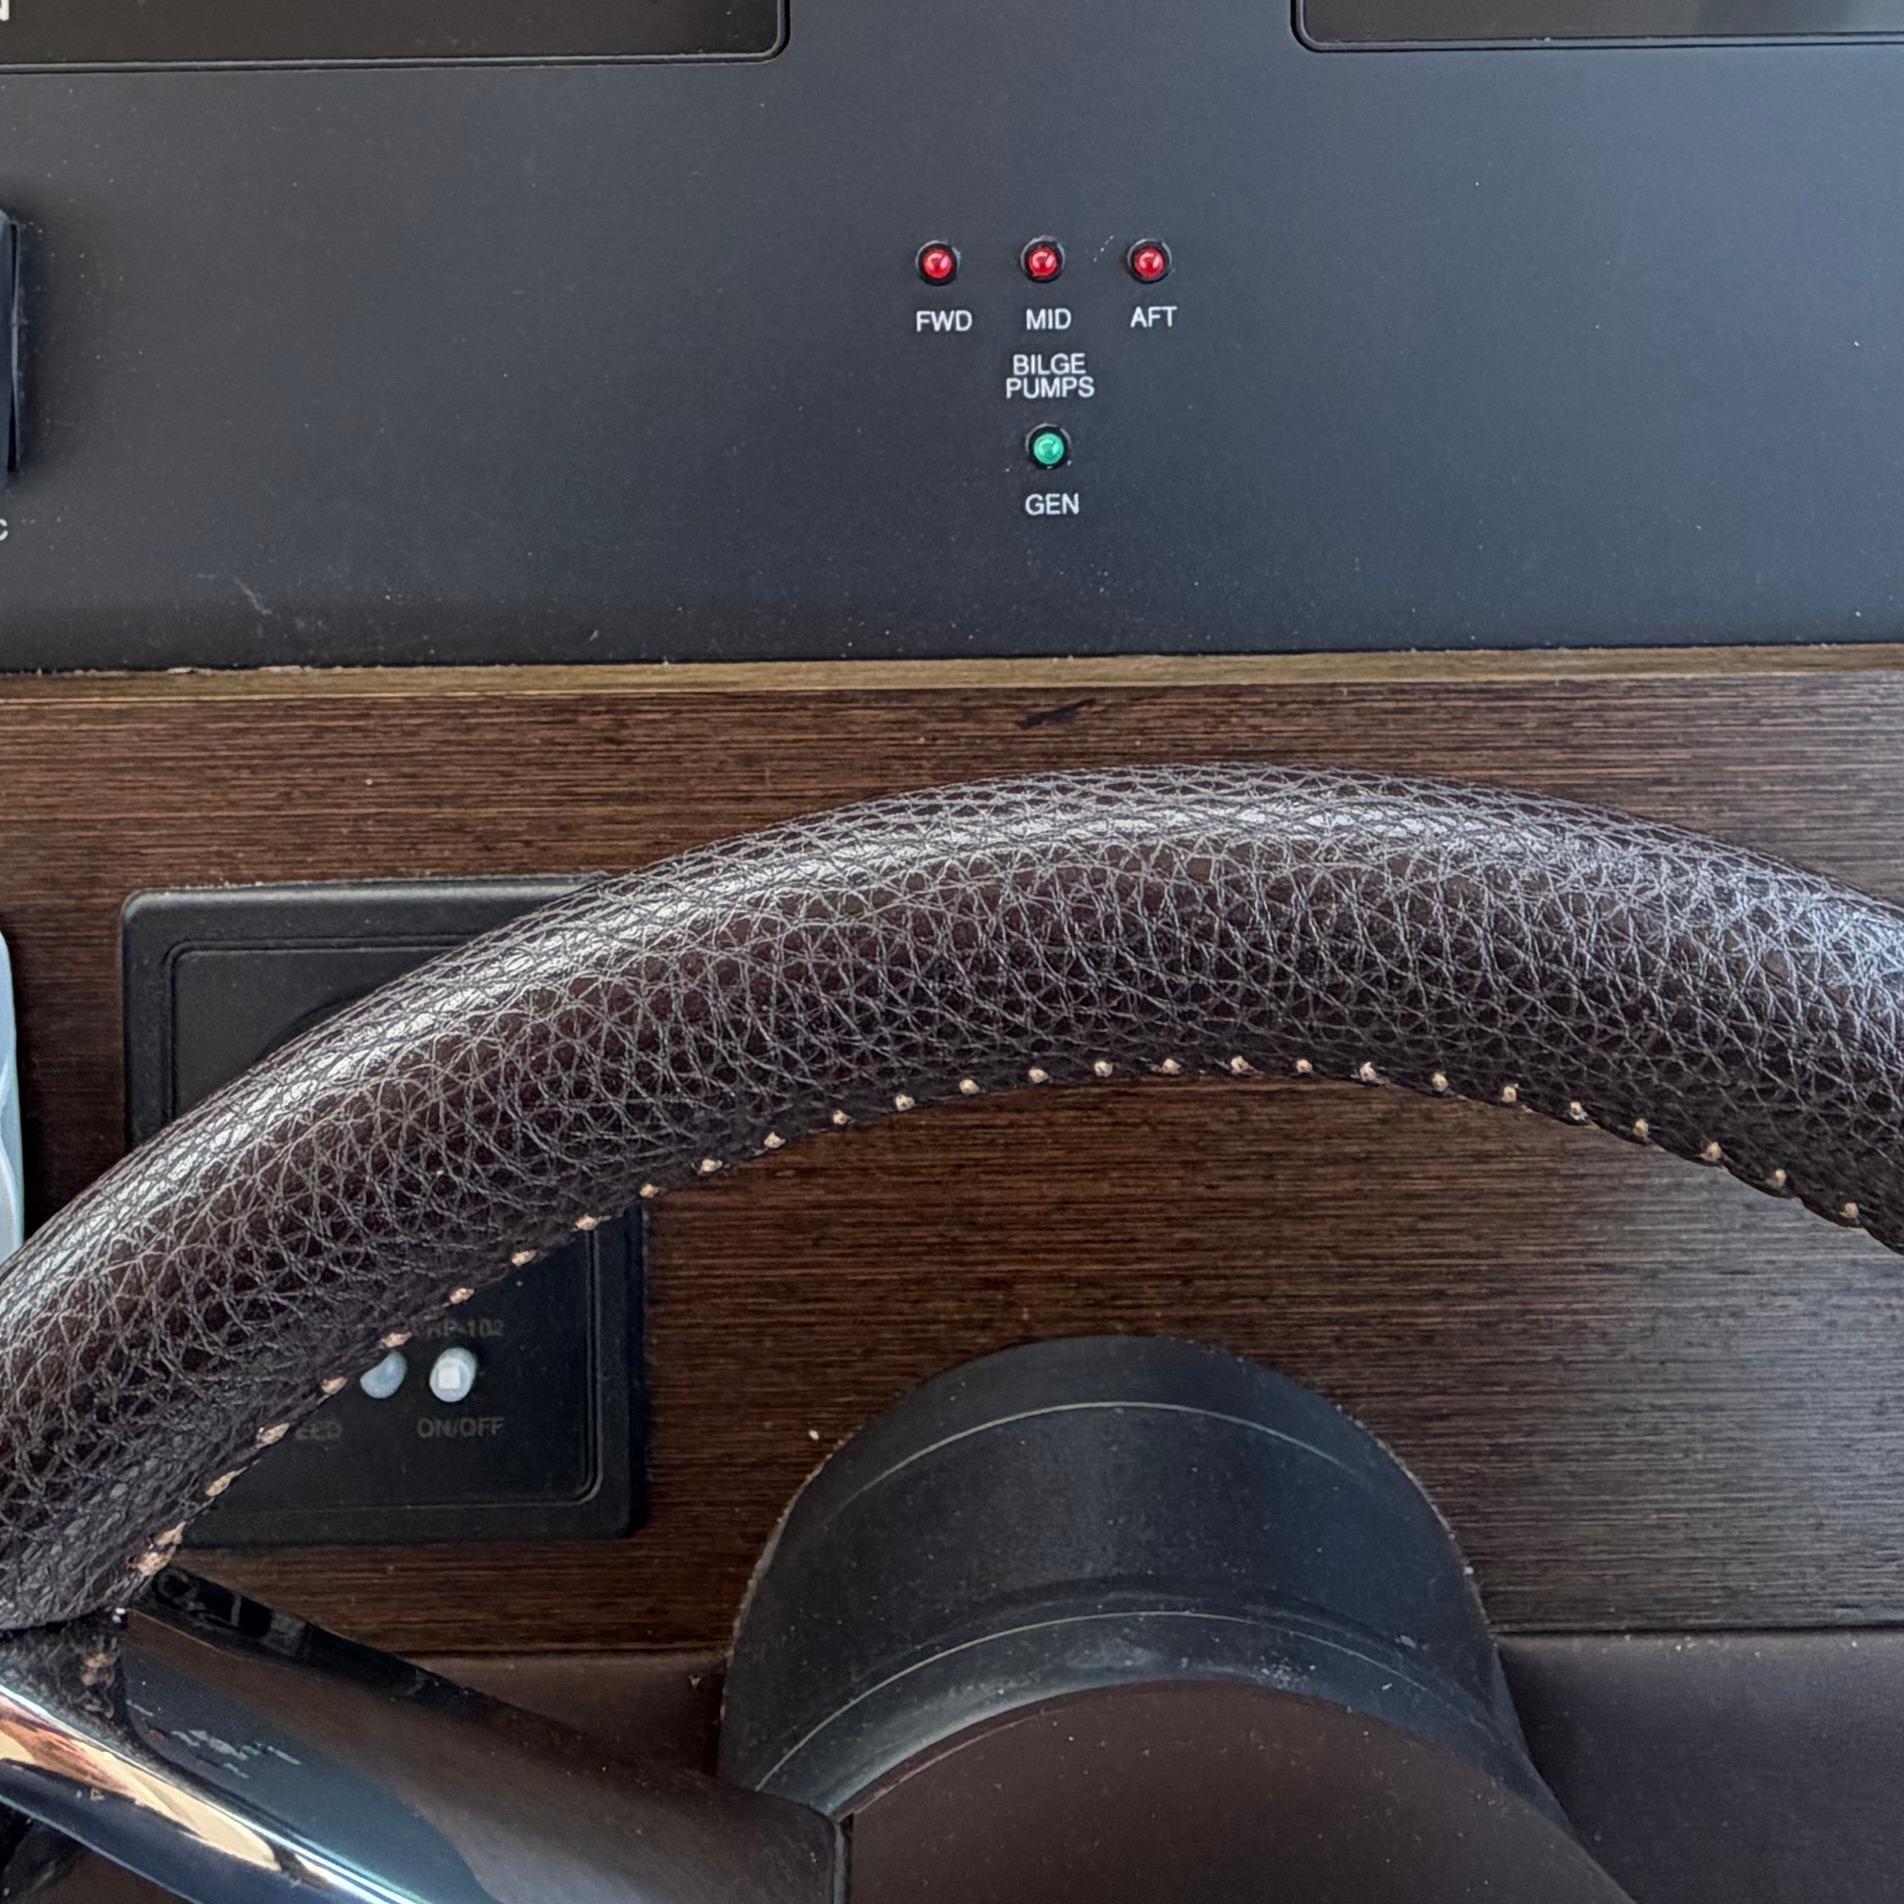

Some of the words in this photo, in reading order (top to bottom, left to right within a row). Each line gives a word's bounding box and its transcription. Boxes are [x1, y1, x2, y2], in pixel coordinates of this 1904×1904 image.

[916, 310, 973, 332] FWD
[1026, 308, 1072, 331] MID
[1130, 306, 1178, 328] AFT
[1013, 353, 1087, 376] BILGE
[1006, 376, 1095, 399] PUMPS
[1024, 493, 1080, 516] GEN
[416, 1416, 505, 1439] ON/OFF
